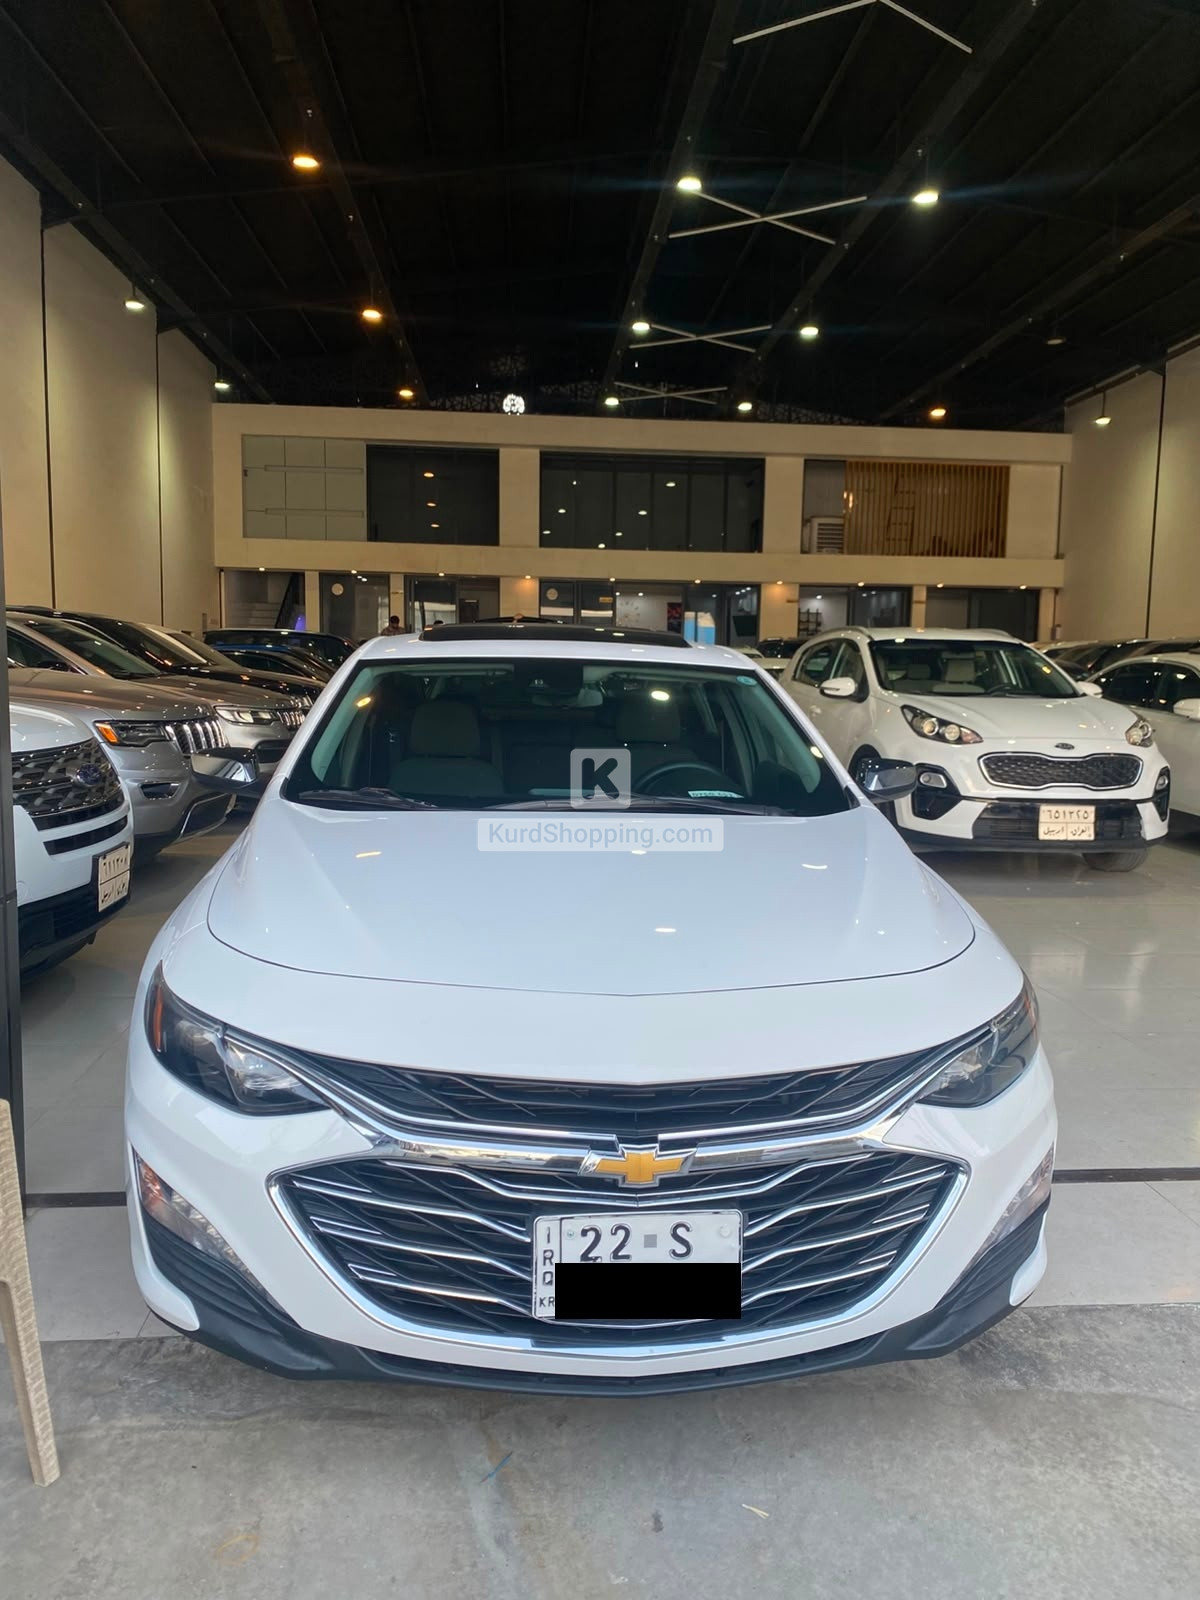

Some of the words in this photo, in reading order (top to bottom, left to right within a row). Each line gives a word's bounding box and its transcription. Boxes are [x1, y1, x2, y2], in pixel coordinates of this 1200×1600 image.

[579, 1224, 633, 1263] 22
[669, 1221, 693, 1260] S
[539, 1296, 555, 1308] KR
